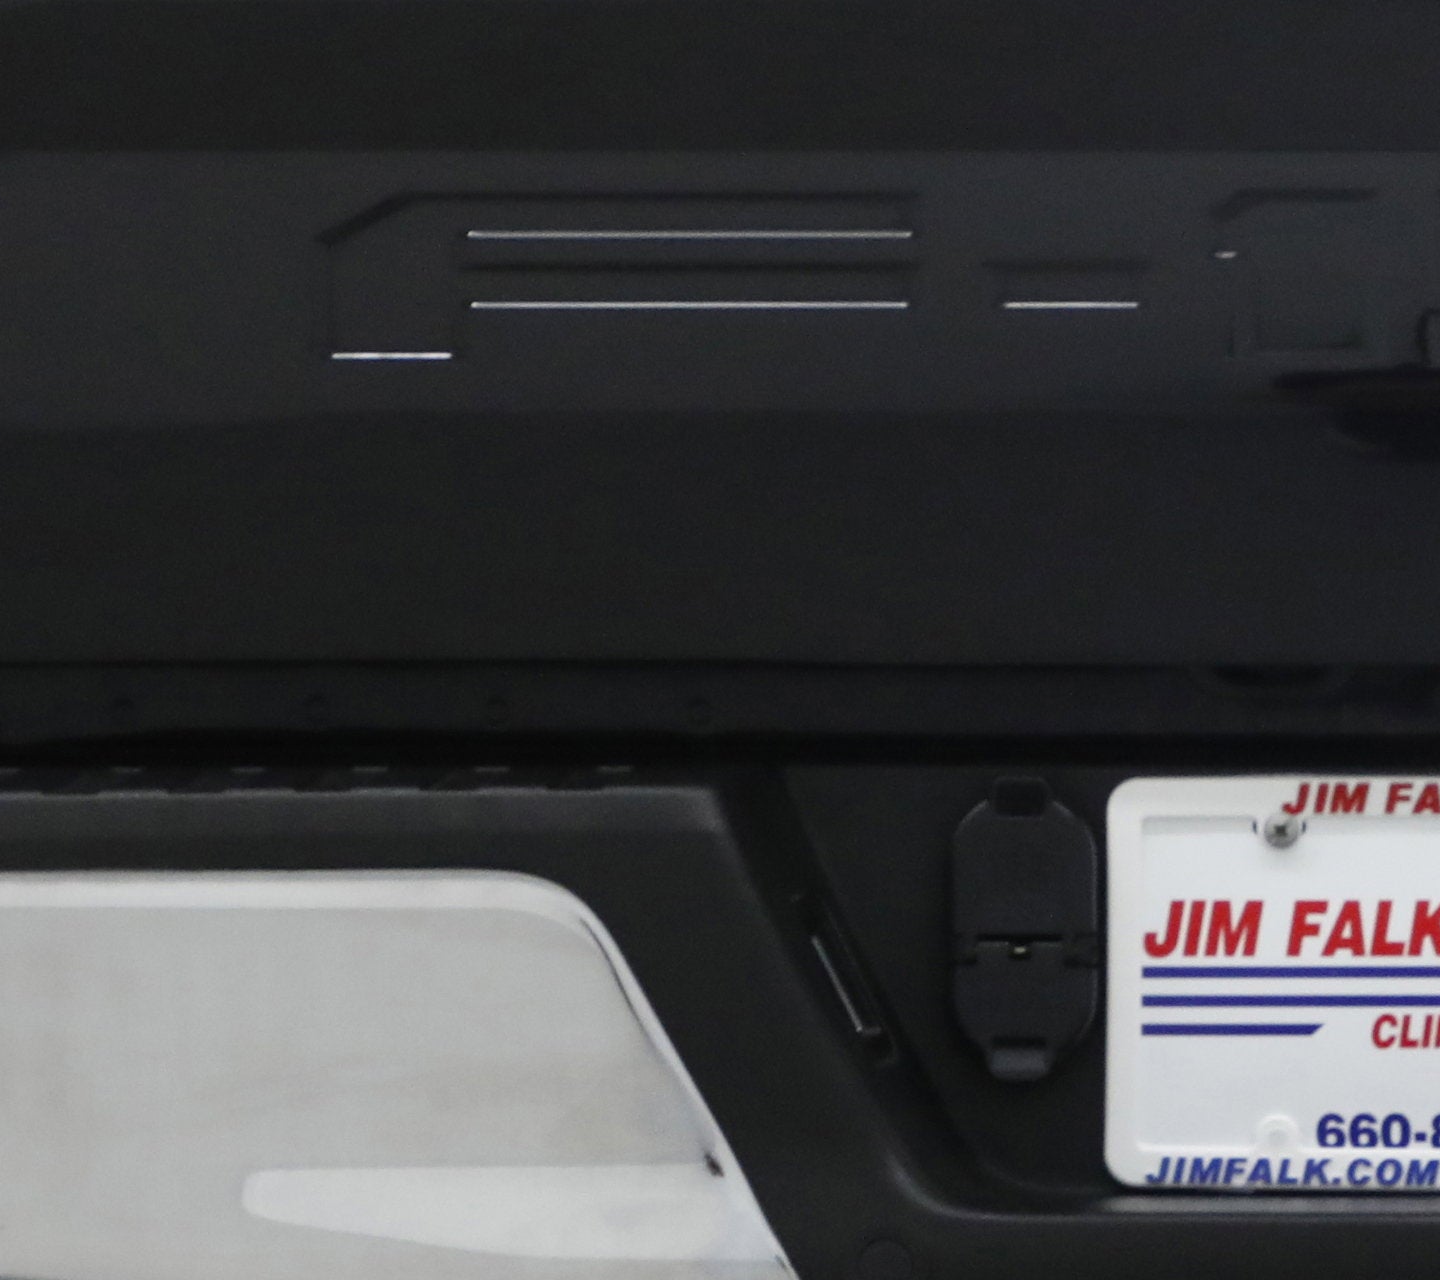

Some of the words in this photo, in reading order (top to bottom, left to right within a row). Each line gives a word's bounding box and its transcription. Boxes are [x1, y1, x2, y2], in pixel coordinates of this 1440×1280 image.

[1283, 783, 1369, 816] JIM
[1143, 899, 1264, 959] JIM
[1146, 1156, 1440, 1186] JIMFALK.COM
